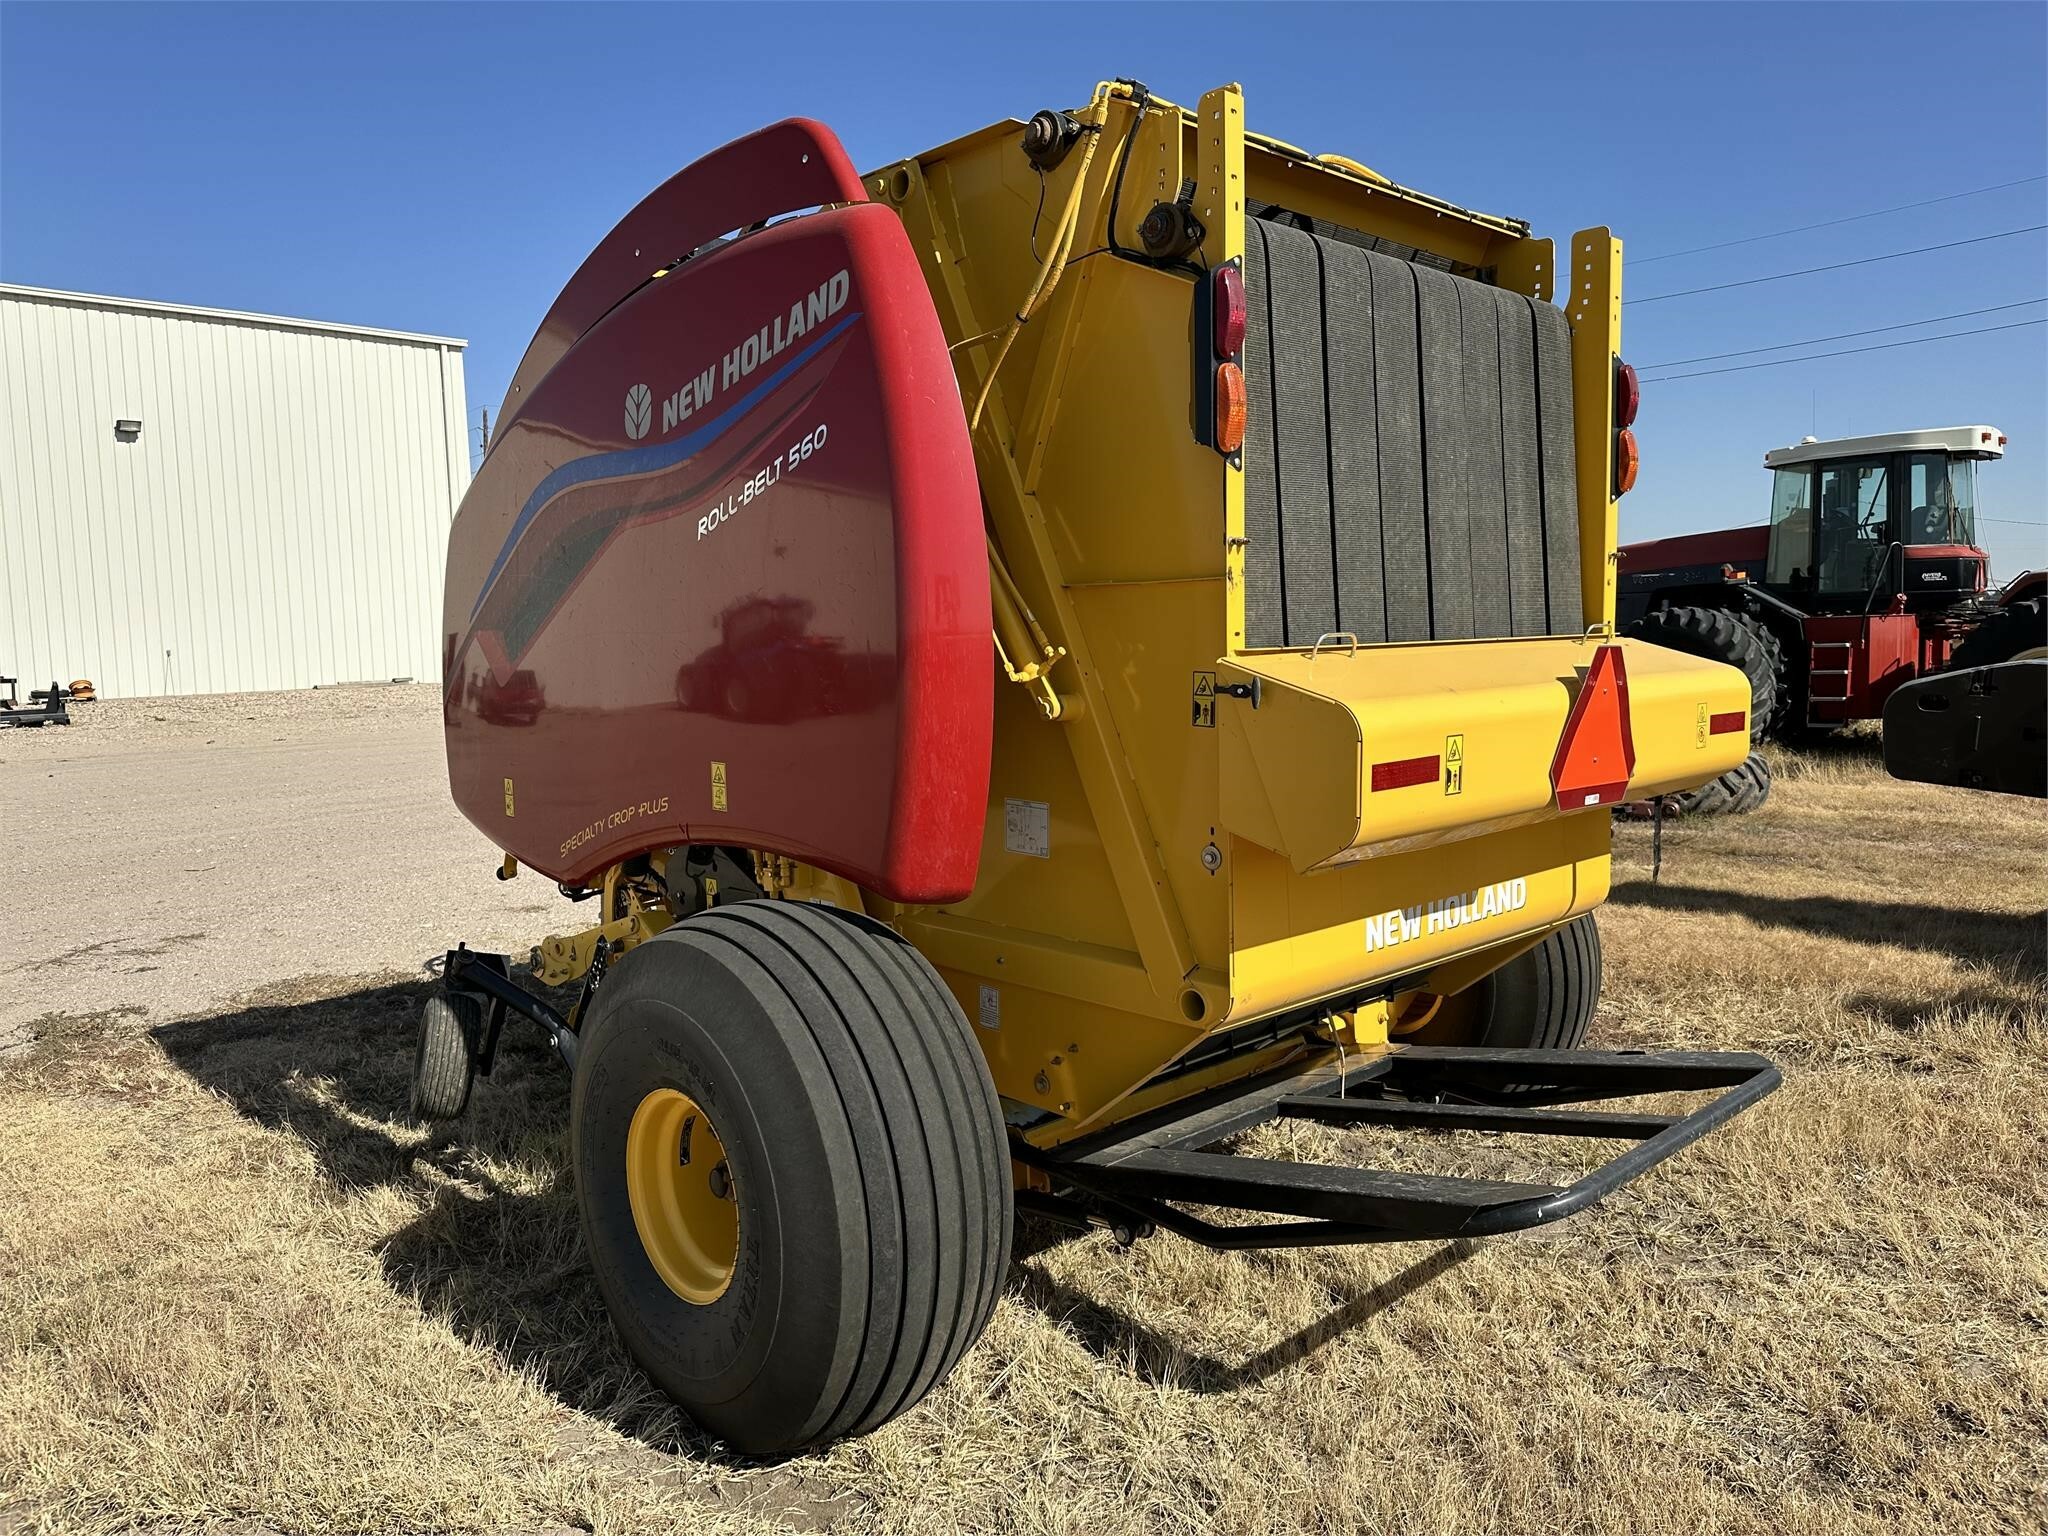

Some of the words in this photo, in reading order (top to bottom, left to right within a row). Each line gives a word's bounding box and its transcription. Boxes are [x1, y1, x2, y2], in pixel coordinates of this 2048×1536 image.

[662, 364, 716, 435] NEW
[722, 269, 850, 392] HOLLAND
[697, 455, 784, 542] ROLL-BELT
[788, 424, 828, 472] 560
[560, 818, 606, 858] SPECIALTY
[607, 806, 635, 829] CROP
[638, 797, 669, 817] PLUS
[1365, 904, 1423, 953] NEW
[1427, 877, 1527, 935] HOLLAND
